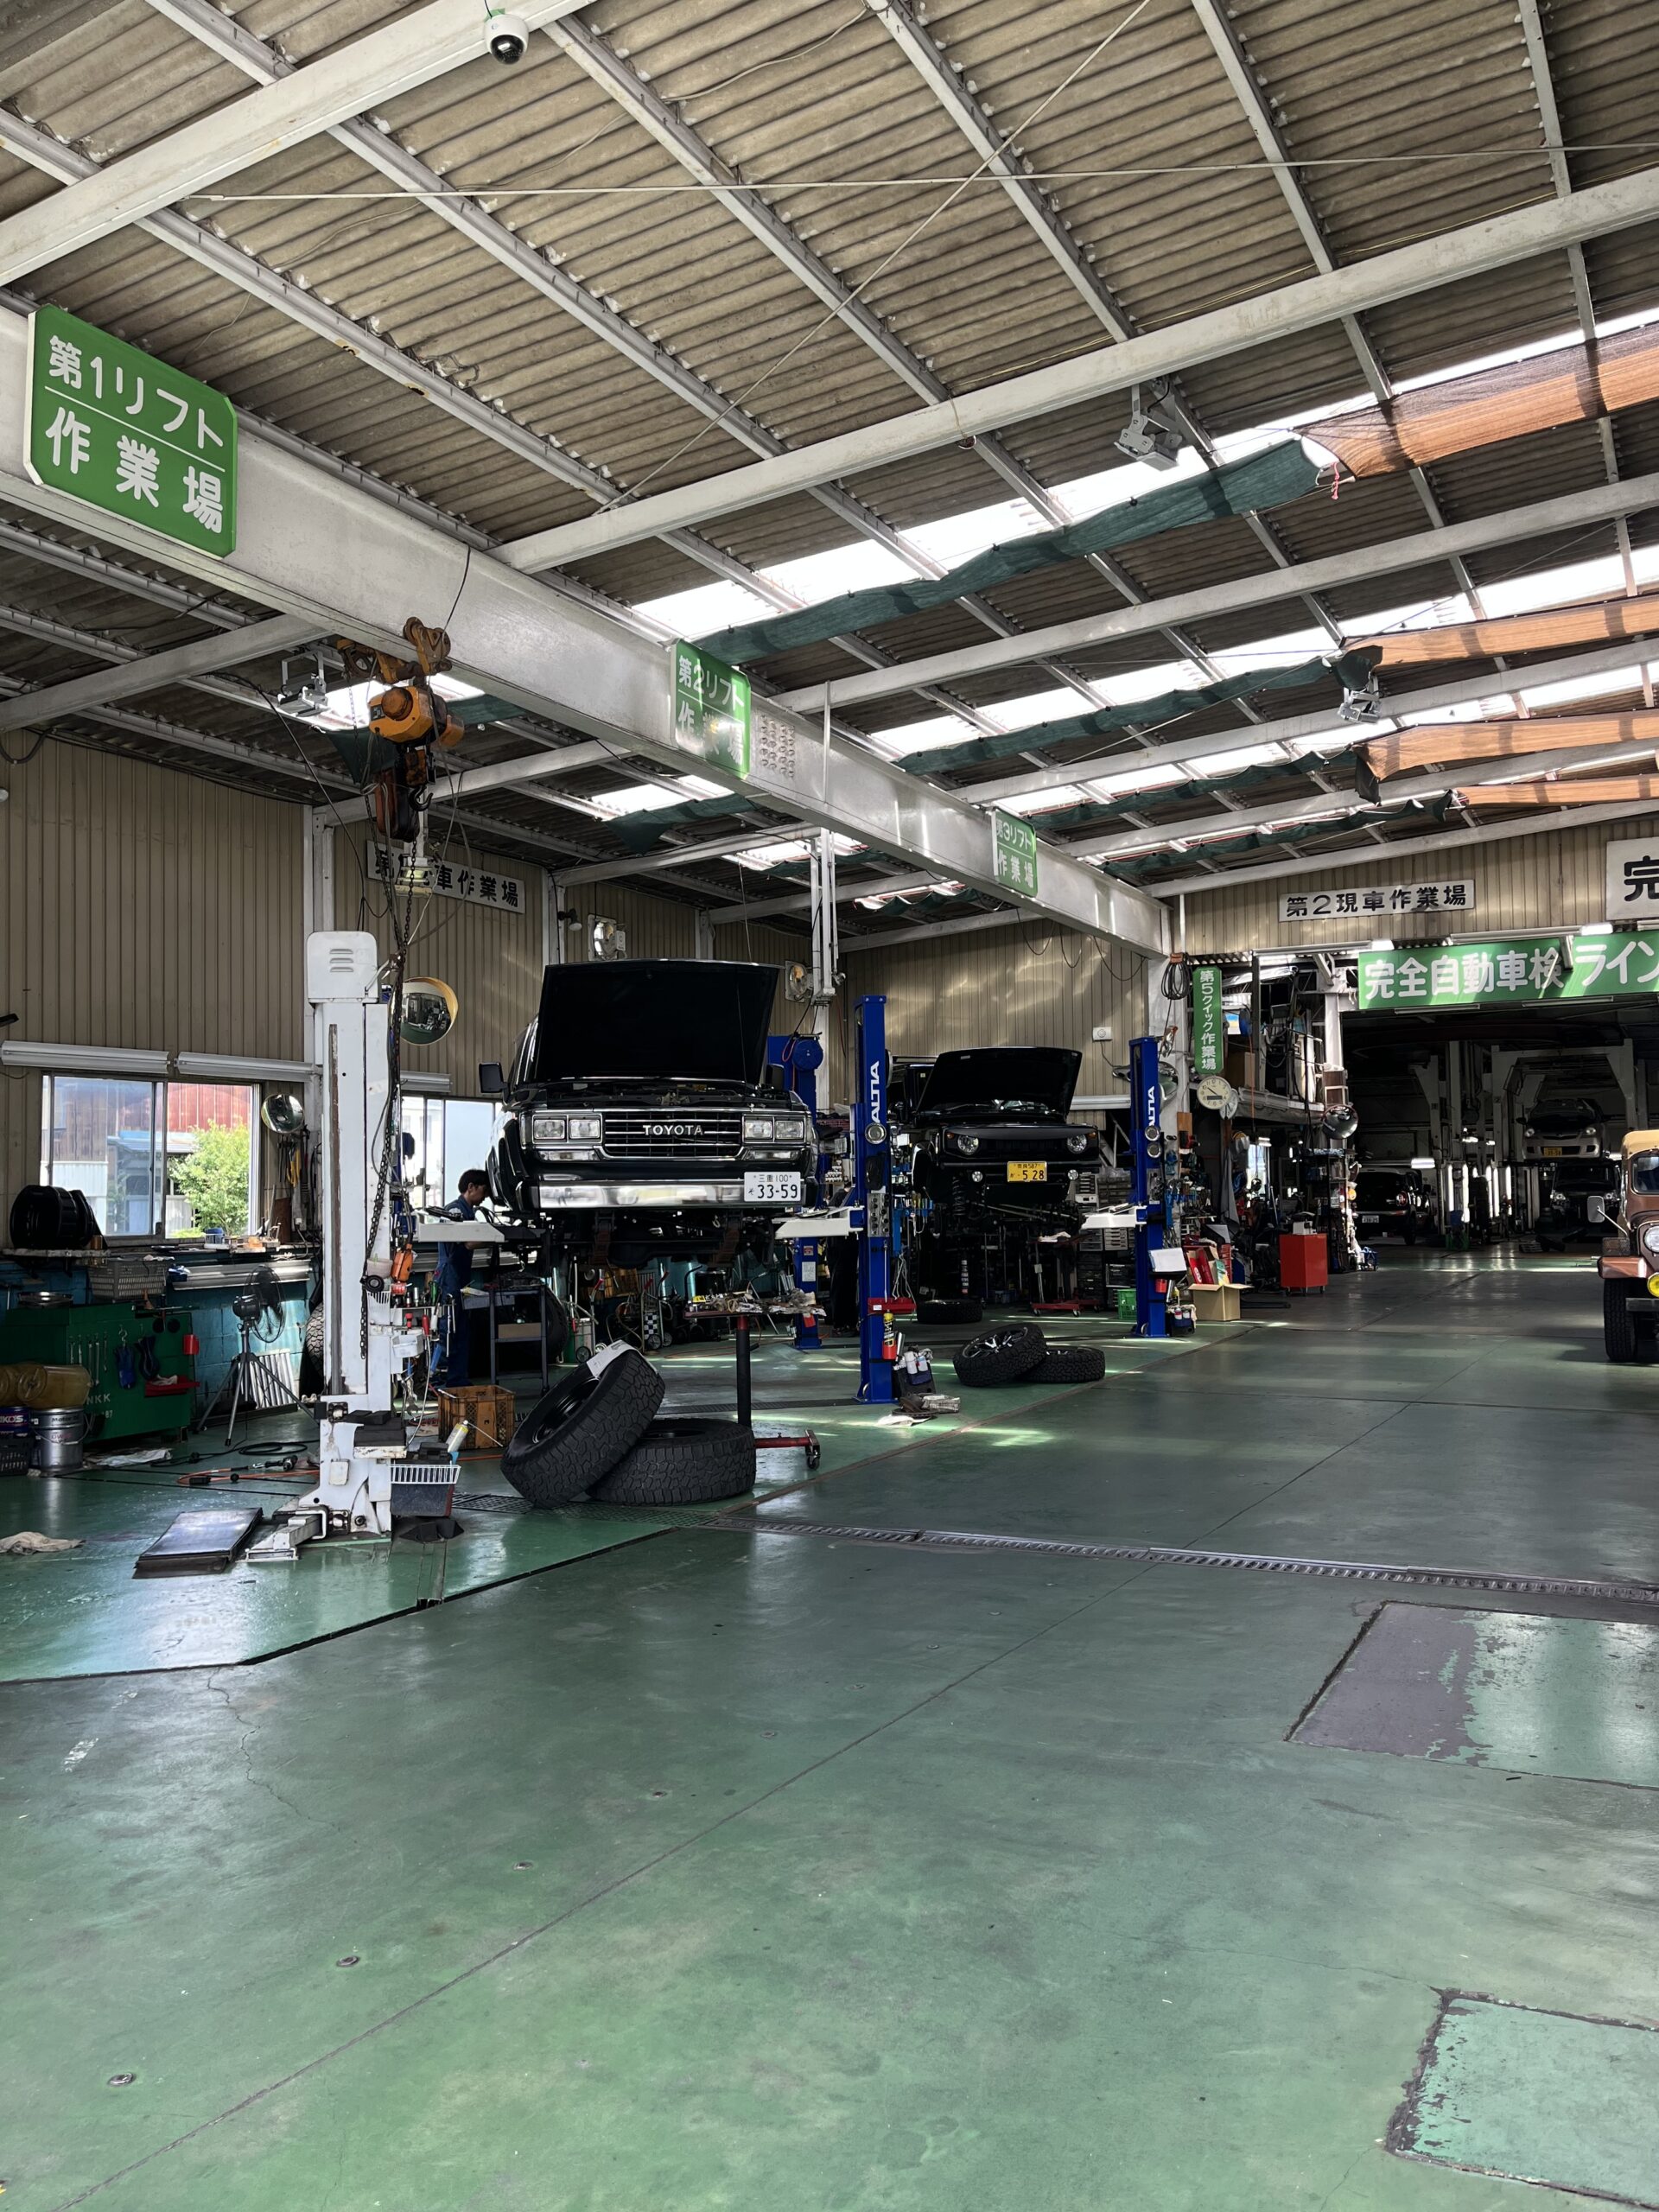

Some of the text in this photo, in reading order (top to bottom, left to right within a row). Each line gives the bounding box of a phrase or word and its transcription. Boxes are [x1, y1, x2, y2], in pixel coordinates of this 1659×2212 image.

[49, 334, 224, 449] 第1リフト
[45, 407, 224, 534] 作業場
[678, 655, 745, 711] 第2リフト
[678, 701, 745, 765] 作業場
[998, 849, 1034, 889] 作業場
[1287, 884, 1466, 918] 第2現車作業場
[1199, 970, 1217, 1071] 第5クイック作業場
[642, 1124, 704, 1136] TOYOTA
[757, 1184, 798, 1199] 33-59
